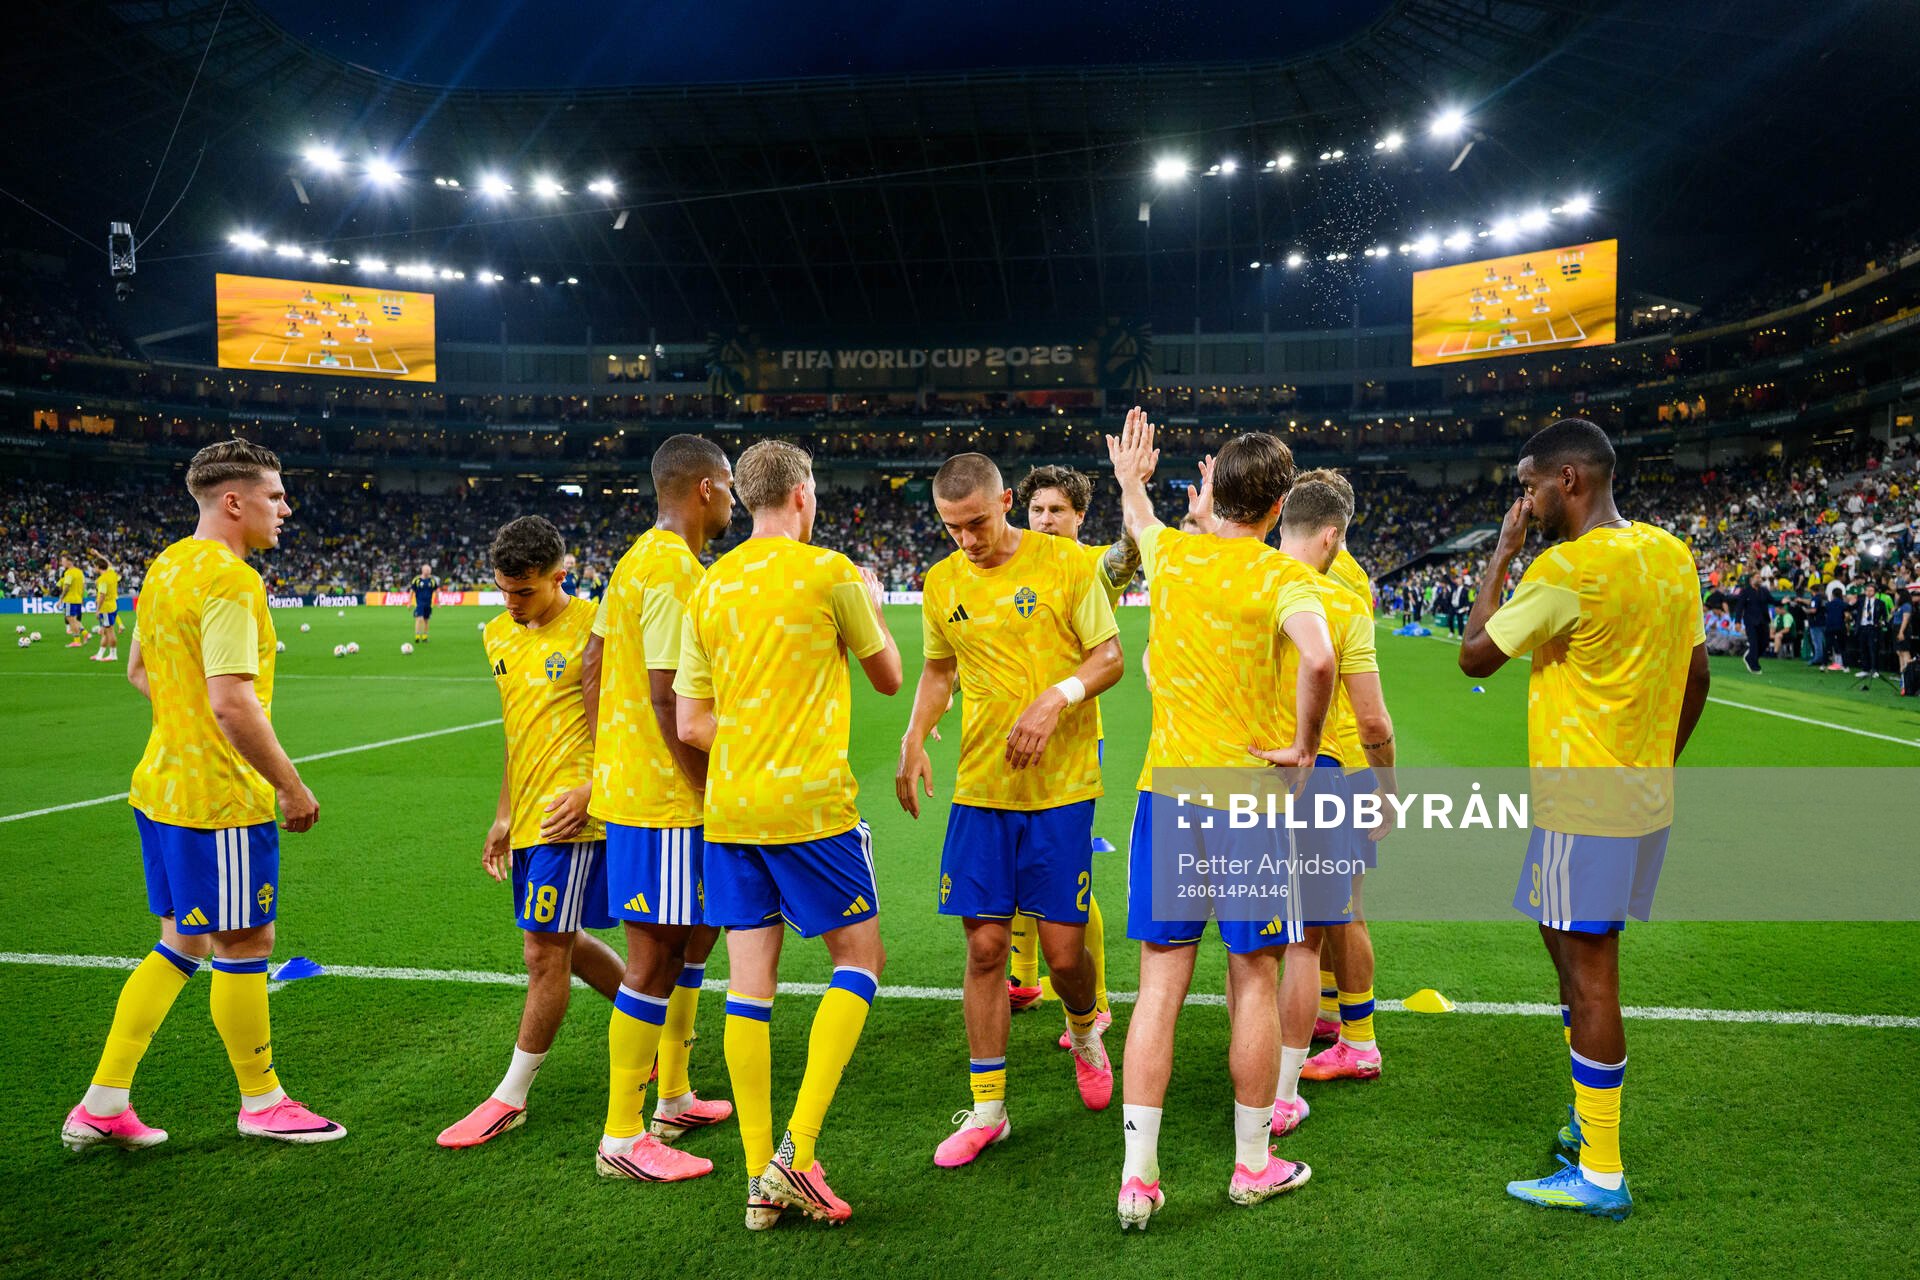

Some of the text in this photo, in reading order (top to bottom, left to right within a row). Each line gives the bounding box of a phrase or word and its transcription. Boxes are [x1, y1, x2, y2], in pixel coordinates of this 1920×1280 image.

[781, 345, 1074, 369] FIFA WORLD CUP 2026
[268, 594, 304, 608] Rexona
[319, 593, 358, 607] Rexona
[1076, 870, 1090, 912] 2
[1529, 863, 1541, 907] 9
[523, 881, 559, 923] 18
